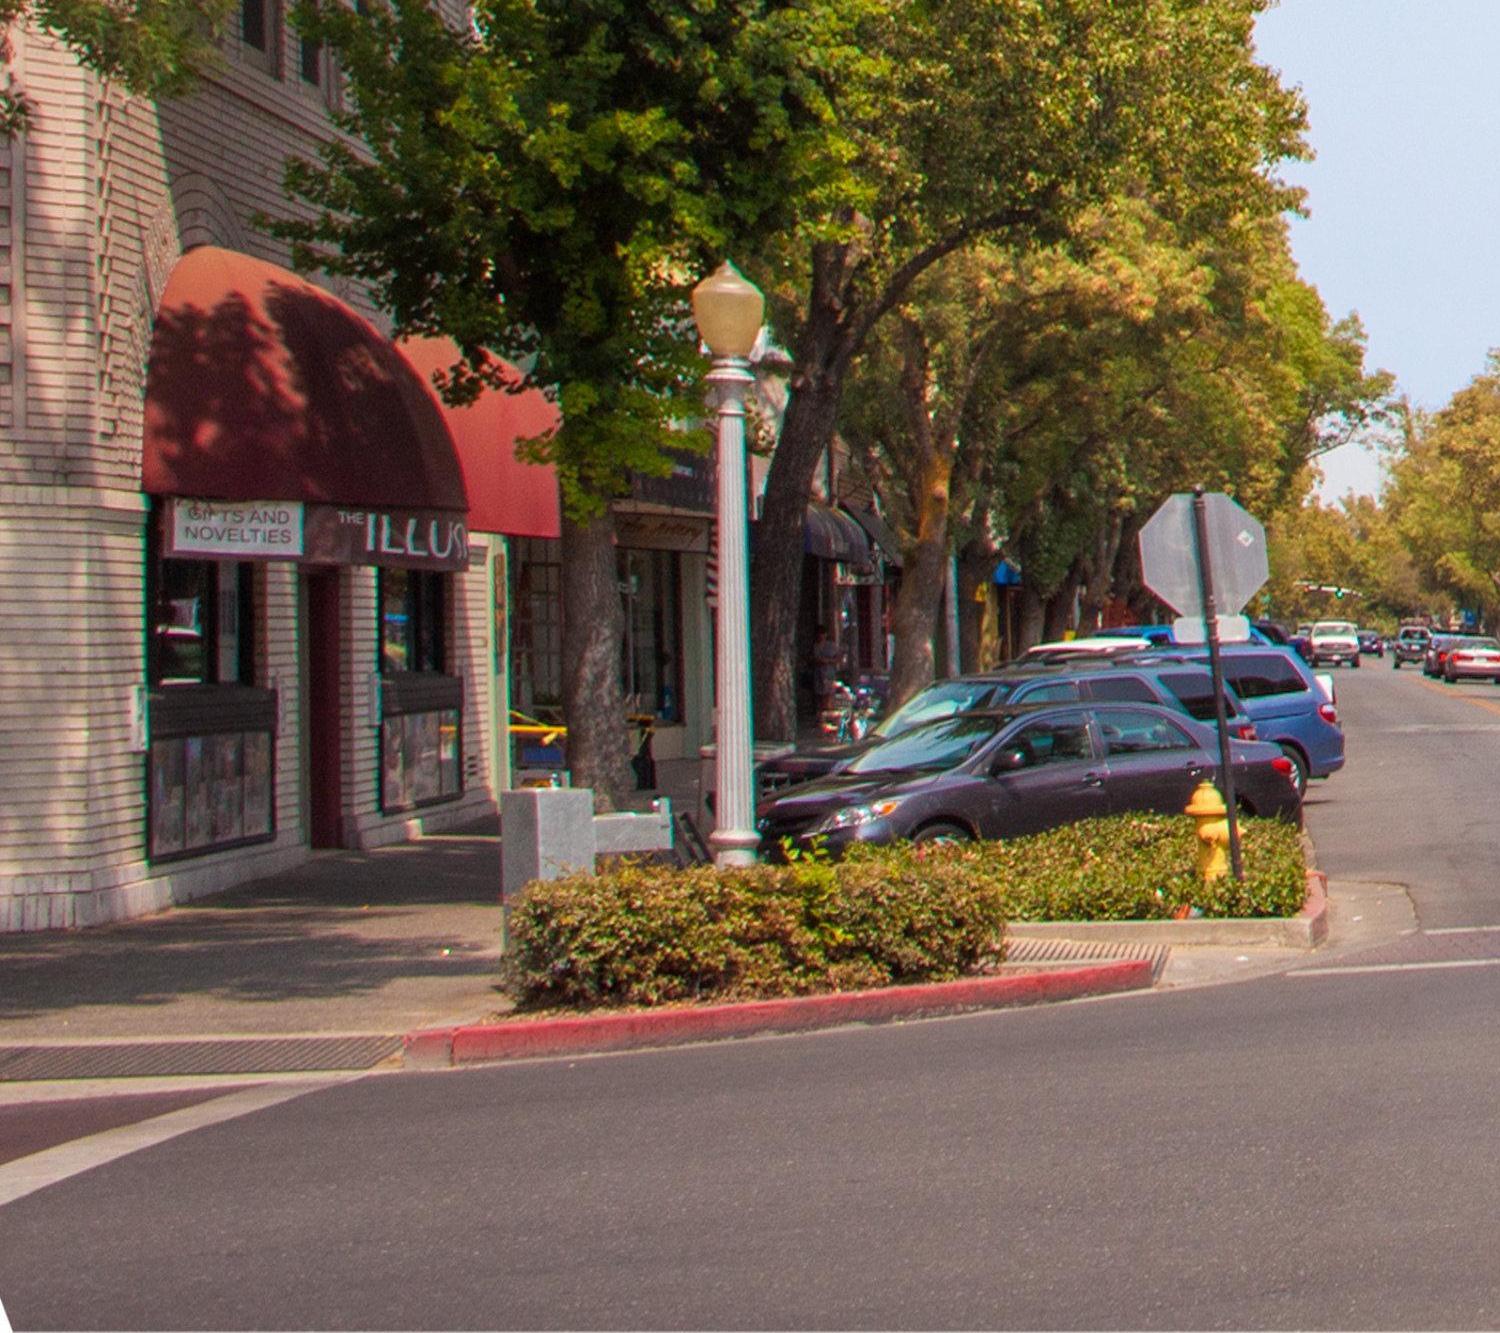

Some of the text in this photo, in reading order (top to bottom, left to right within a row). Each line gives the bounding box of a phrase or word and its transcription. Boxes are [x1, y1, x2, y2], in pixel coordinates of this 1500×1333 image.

[187, 506, 290, 525] GIFTS AND
[338, 510, 365, 525] THE
[185, 525, 292, 544] NOVELTIES
